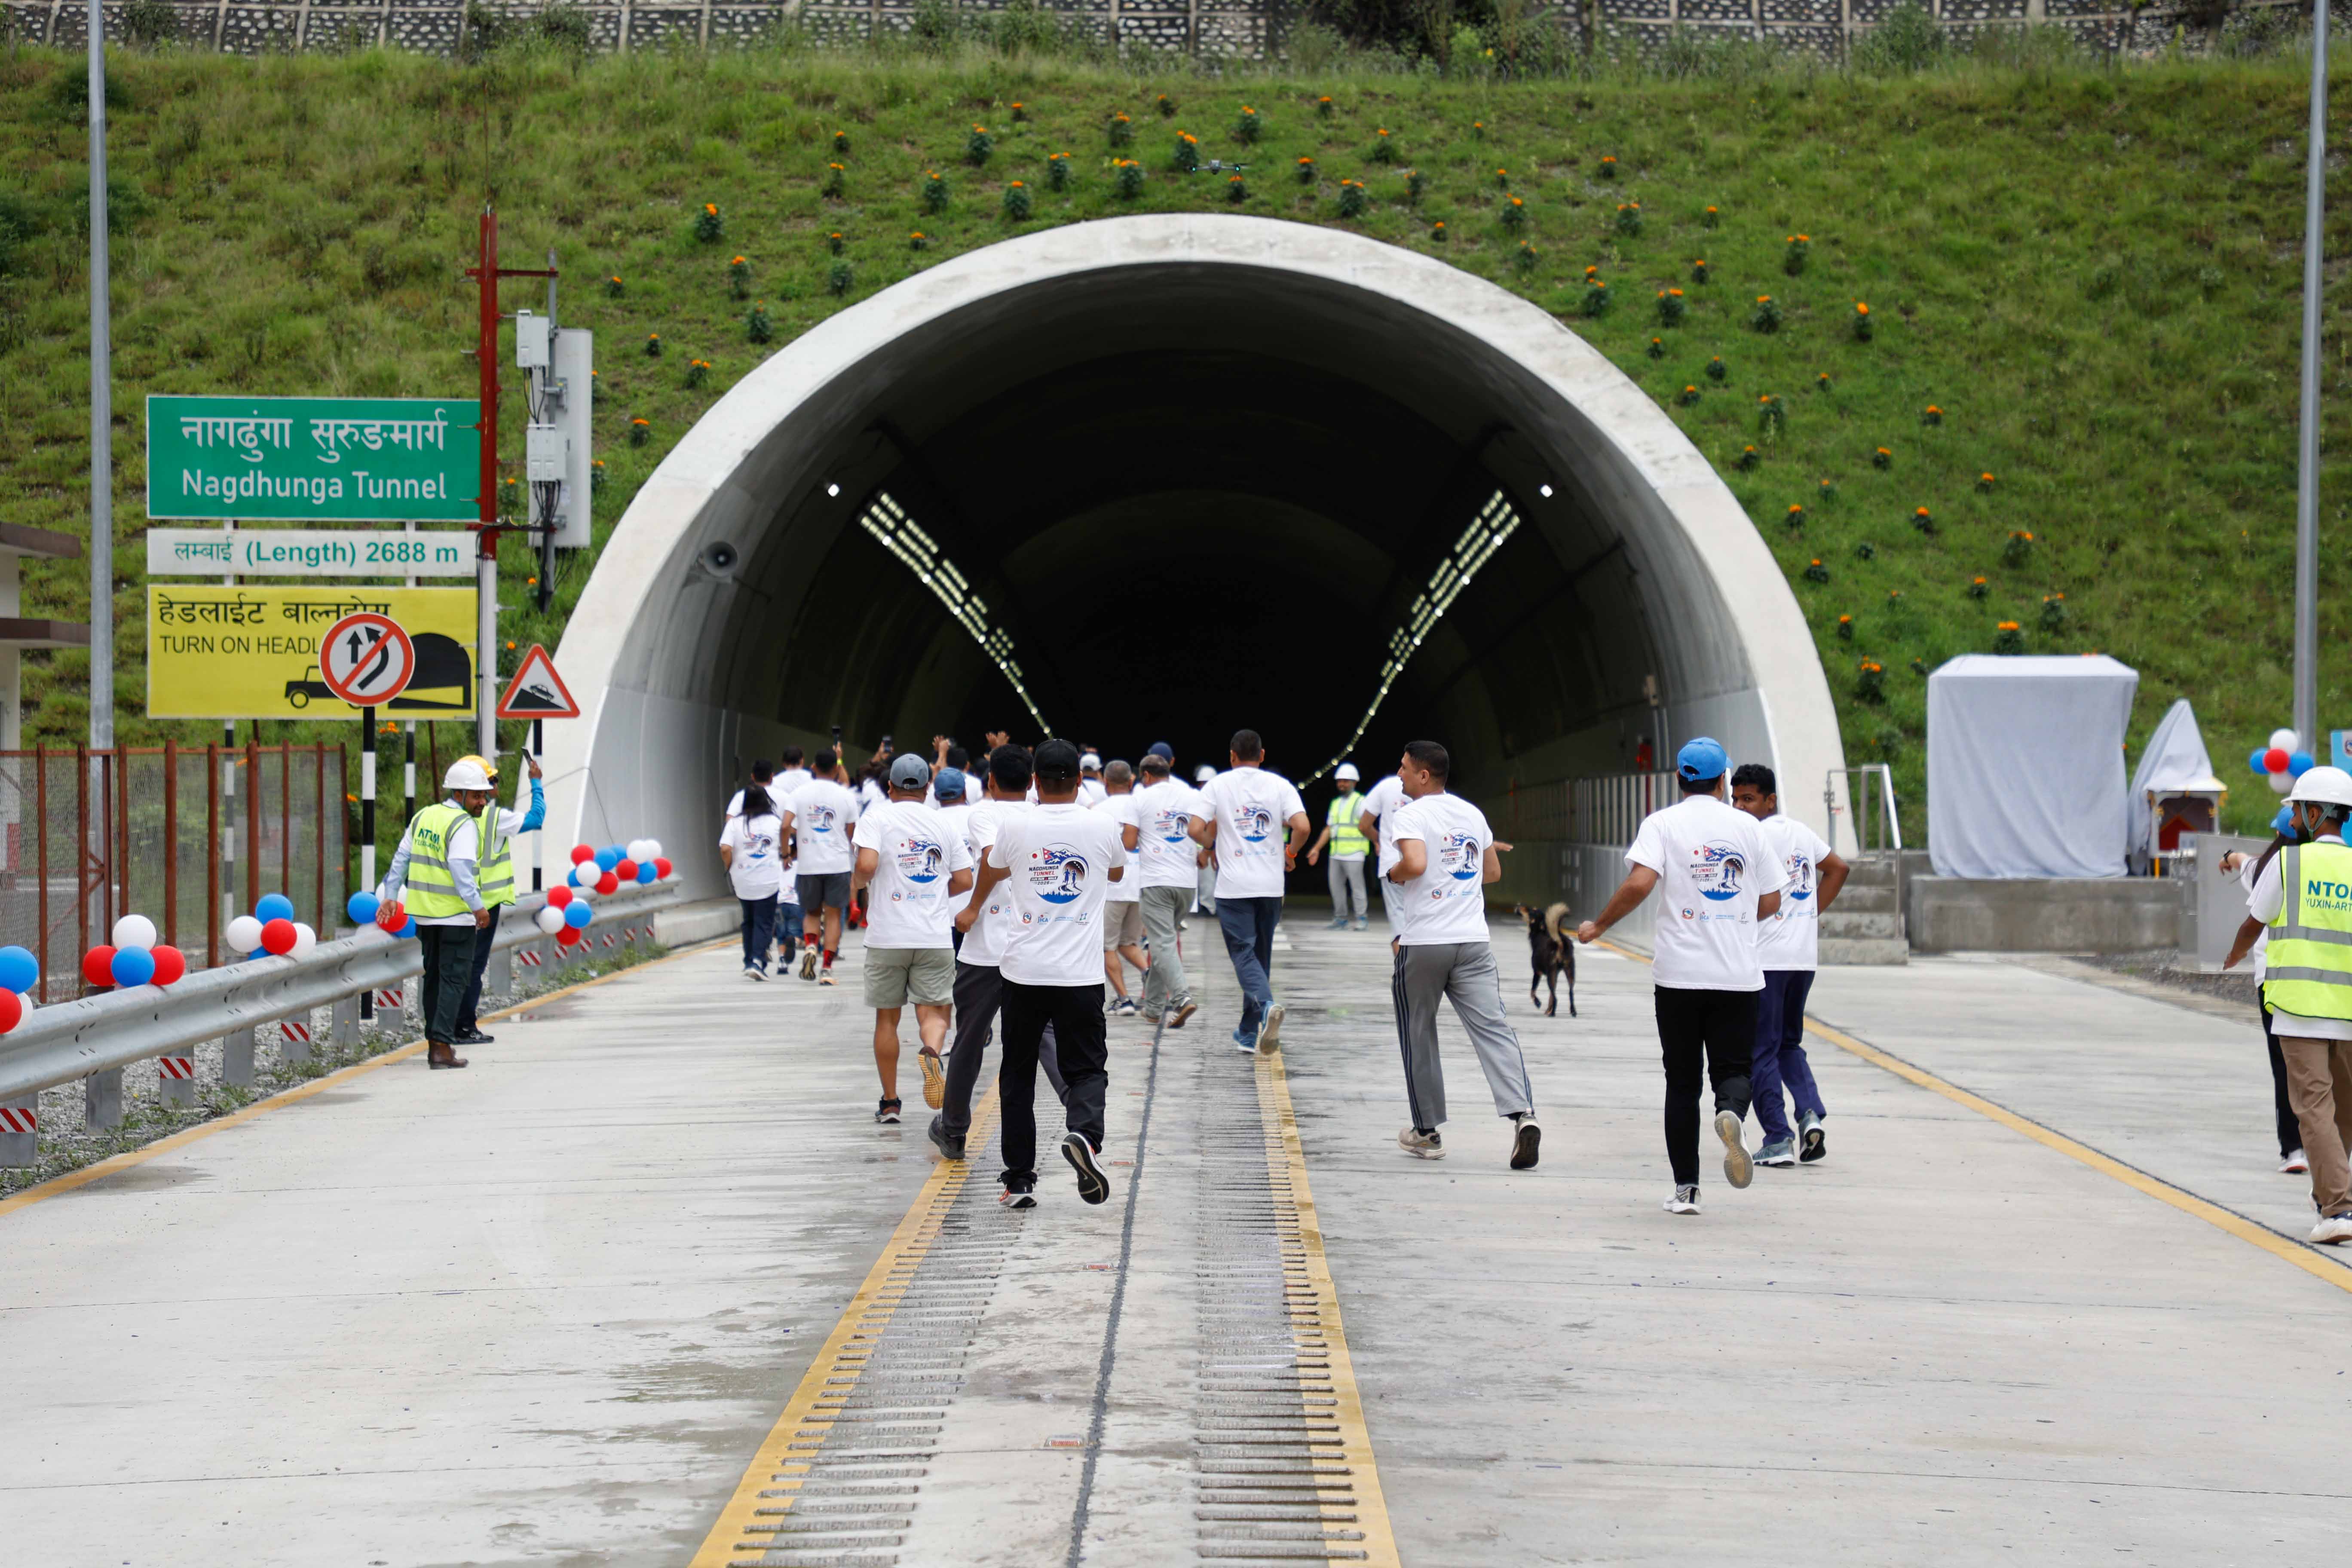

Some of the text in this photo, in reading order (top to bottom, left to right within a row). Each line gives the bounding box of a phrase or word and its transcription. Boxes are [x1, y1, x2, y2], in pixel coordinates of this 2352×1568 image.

[180, 410, 293, 462] नागढुंगा
[182, 469, 446, 505] Nagdhunga Tunnel
[175, 536, 459, 567] लम्बाई (Length) 2688 m
[158, 593, 267, 626] हेडलाईट
[159, 636, 214, 654] TURN
[221, 636, 249, 654] ON
[2307, 880, 2352, 901] NTO
[1038, 915, 1049, 924] JICA
